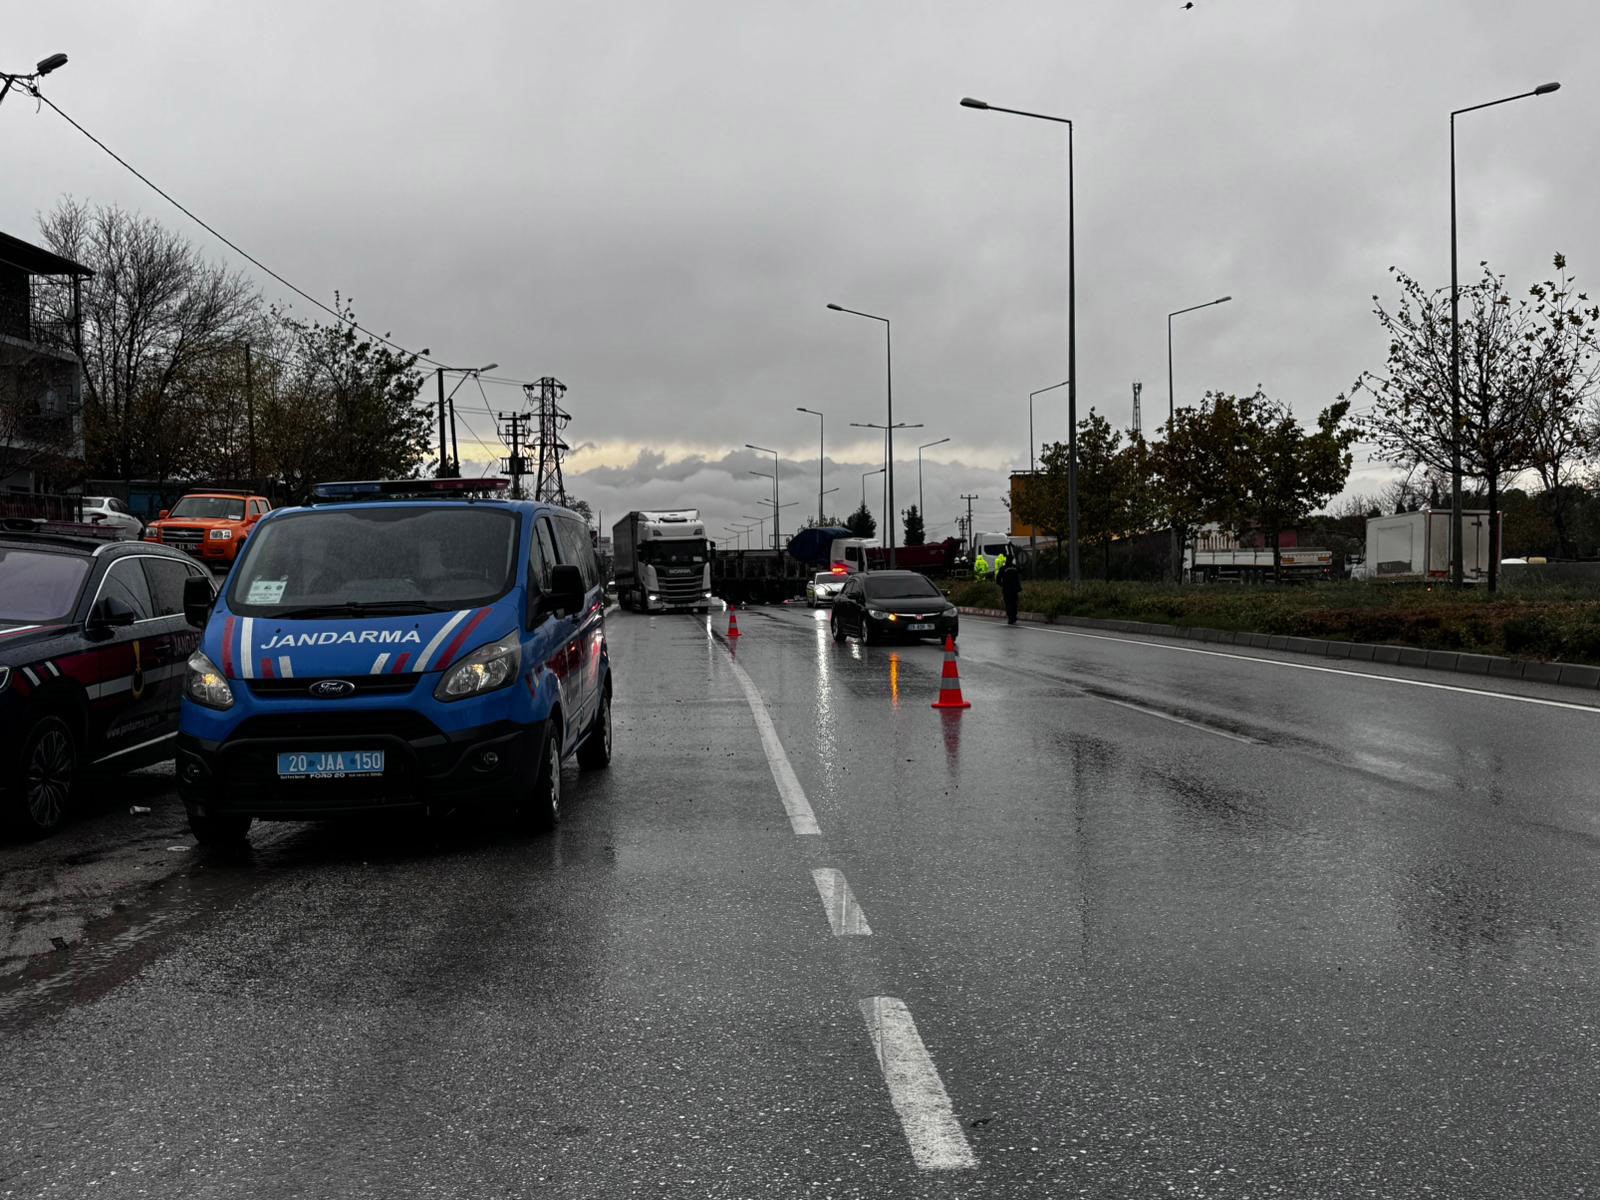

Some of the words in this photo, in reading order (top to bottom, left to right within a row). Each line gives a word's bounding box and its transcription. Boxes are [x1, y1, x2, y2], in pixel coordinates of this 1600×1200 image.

[260, 629, 421, 650] JANDARMA
[319, 683, 344, 695] Ford
[289, 755, 307, 772] 20
[316, 754, 344, 771] JAA
[354, 752, 381, 769] 150
